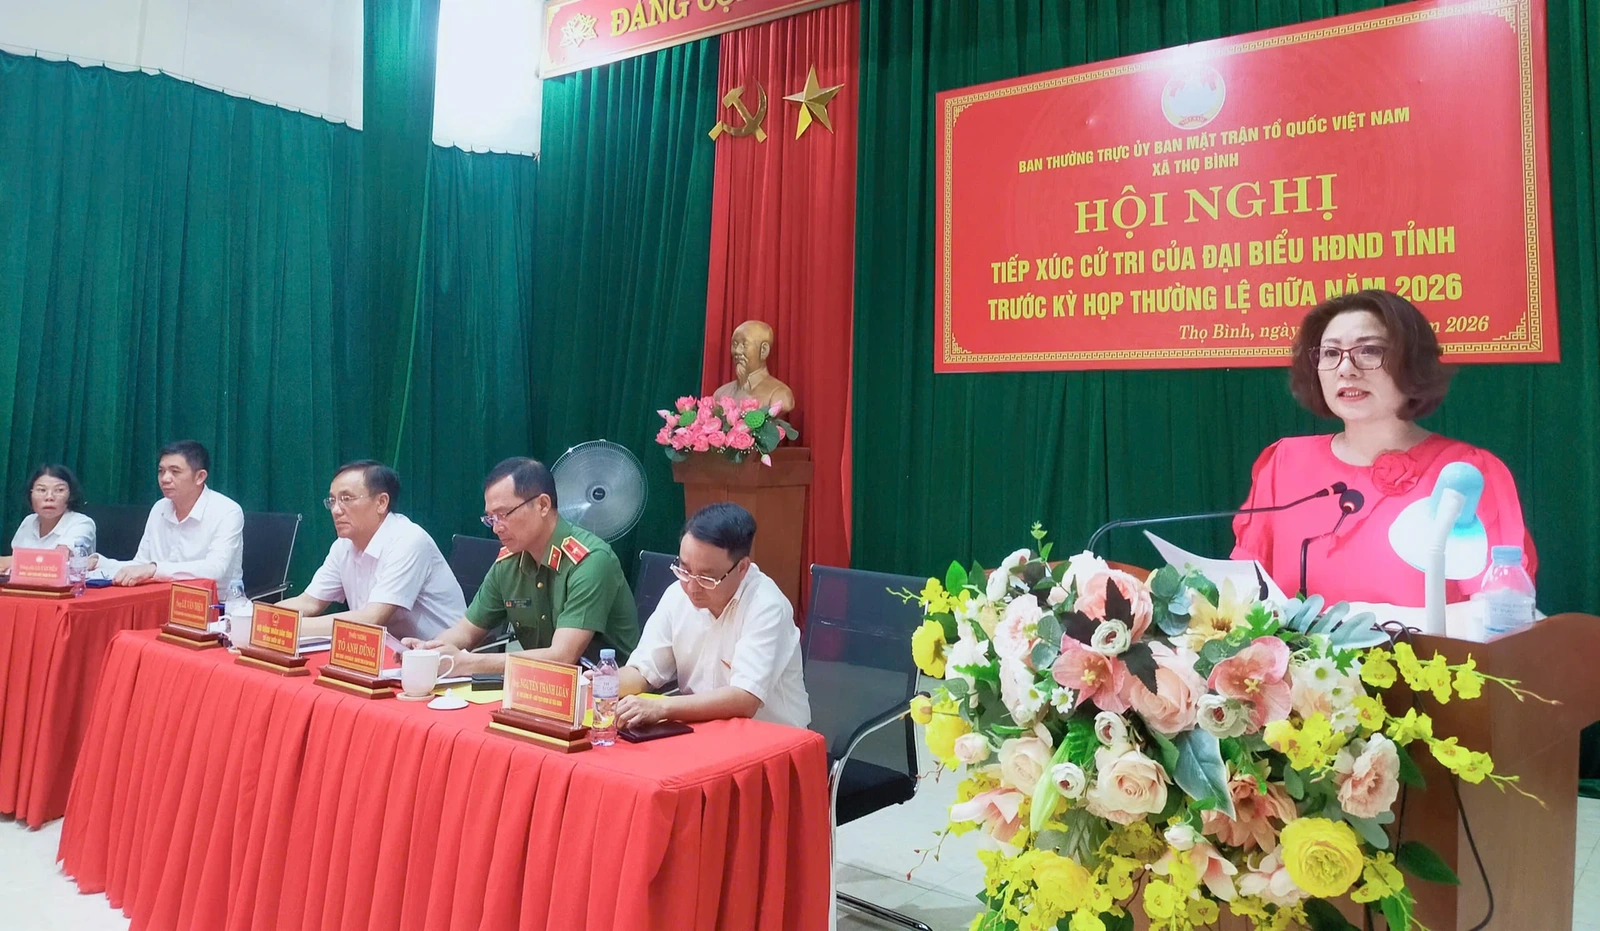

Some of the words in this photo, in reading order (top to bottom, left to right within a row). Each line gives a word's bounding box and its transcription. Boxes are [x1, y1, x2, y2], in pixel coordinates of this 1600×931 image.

[1018, 158, 1043, 173] BAN
[1046, 150, 1094, 168] THƯỜNG
[1098, 144, 1130, 162] TRỰC
[1134, 140, 1150, 157] ỦY
[1154, 138, 1182, 154] BAN
[1186, 132, 1216, 150] MẶT
[1221, 126, 1258, 146] TRẬN
[1263, 118, 1282, 140] TỔ
[1286, 114, 1328, 138] QUỐC
[1332, 111, 1366, 132] VIỆT
[1370, 106, 1410, 126] NAM
[1152, 159, 1170, 176] XÃ
[1174, 158, 1200, 175] THỌ
[1204, 152, 1238, 170] BÌNH
[1074, 184, 1168, 240] HỘI
[1184, 173, 1338, 224] NGHỊ
[991, 254, 1030, 284] TIẾP
[1036, 252, 1074, 281] XÚC
[1080, 246, 1110, 278] CỬ
[1112, 250, 1144, 275] TRI
[1152, 240, 1196, 272] CỦA
[1202, 242, 1241, 273] ĐẠI
[1249, 228, 1304, 266] BIỂU
[1312, 232, 1384, 262] HĐND
[1392, 220, 1456, 257] TỈNH
[988, 292, 1047, 321] TRƯỚC
[1052, 290, 1077, 318] KỲ
[1084, 292, 1124, 320] HỌP
[1130, 282, 1217, 314] THƯỜNG
[1224, 278, 1251, 314] LỆ
[1259, 276, 1317, 308] GIỮA
[1325, 272, 1386, 300] NĂM
[1395, 273, 1463, 302] 2026
[1179, 324, 1208, 343] Thọ
[1212, 322, 1254, 340] Bình,
[1260, 322, 1300, 340] ngày
[1445, 315, 1490, 332] 2026
[346, 642, 358, 654] ANH
